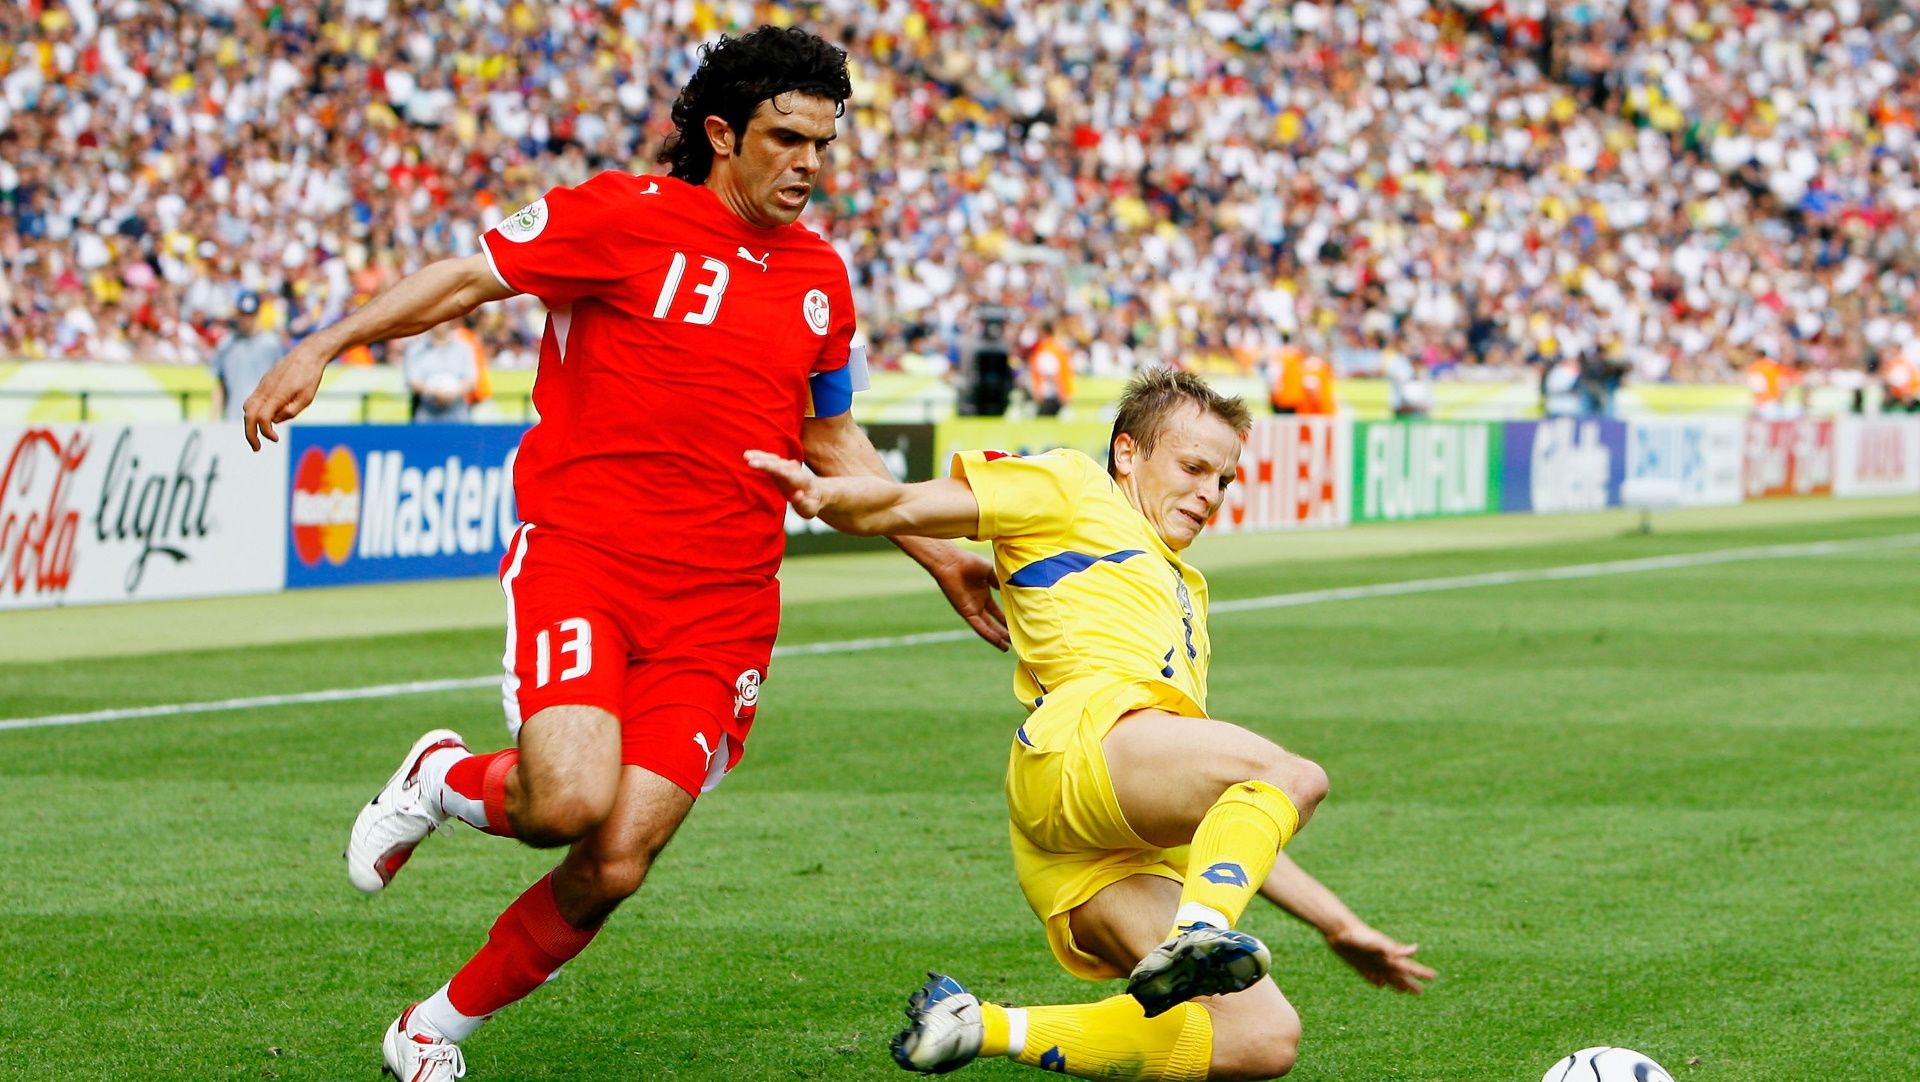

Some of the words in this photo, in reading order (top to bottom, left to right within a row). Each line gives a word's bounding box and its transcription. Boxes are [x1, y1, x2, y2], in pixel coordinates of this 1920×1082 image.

[652, 251, 730, 325] 13
[94, 426, 219, 593] light
[1206, 420, 1340, 528] SHIBA
[535, 616, 592, 689] 13
